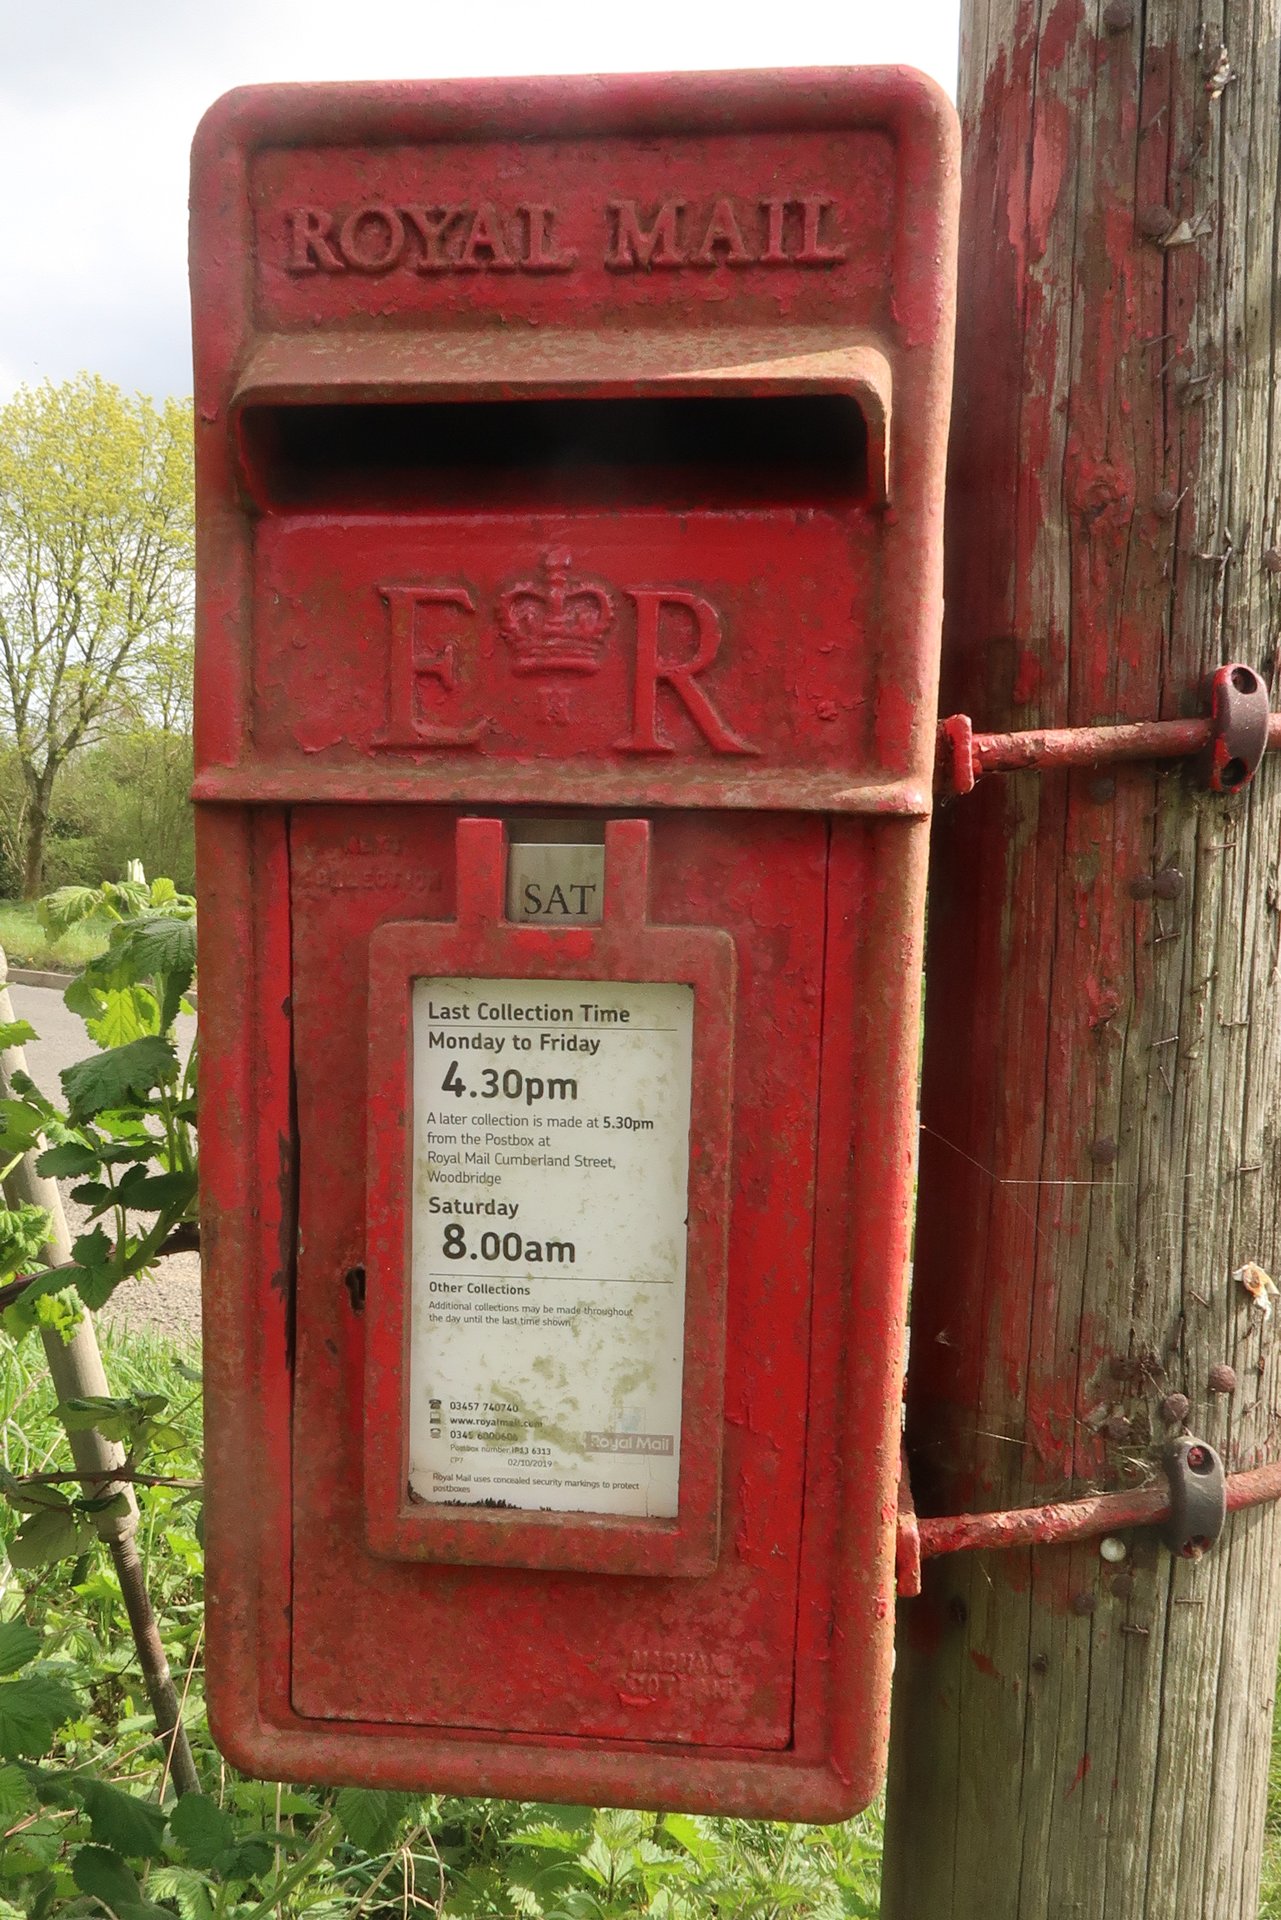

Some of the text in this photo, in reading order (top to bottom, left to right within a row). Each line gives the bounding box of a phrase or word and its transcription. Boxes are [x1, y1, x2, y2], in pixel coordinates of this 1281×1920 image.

[286, 198, 848, 274] ROYAL MAIL
[368, 585, 762, 754] E R
[524, 884, 597, 915] SAT
[428, 1002, 630, 1022] Last Collection Time
[428, 1032, 600, 1055] Monday to Friday
[441, 1060, 578, 1106] 4.30pm
[427, 1113, 654, 1131] A later collection is made at 5.30pm
[427, 1133, 550, 1147] from the Postbox at
[427, 1152, 616, 1169] Royal Mail Cumberland Street,
[428, 1171, 502, 1185] Woodbridge
[429, 1197, 519, 1219] Saturday
[442, 1223, 576, 1263] 8.00am
[429, 1282, 530, 1295] Other Collections
[429, 1301, 633, 1318] Additional collections may be made throughout
[429, 1313, 443, 1322] the
[445, 1314, 461, 1324] day
[463, 1315, 482, 1323] until
[485, 1315, 499, 1324] the
[502, 1315, 518, 1325] last
[520, 1316, 540, 1326] time
[450, 1402, 518, 1412] 03457 740740
[450, 1418, 542, 1428] www.royalmail.com
[450, 1430, 473, 1439] 0345
[591, 1435, 669, 1450] Royal Mail
[532, 1447, 551, 1455] 6313
[508, 1459, 552, 1467] 02/10/2019
[432, 1472, 453, 1481] Royal
[456, 1474, 471, 1482] Mail
[493, 1477, 530, 1485] concealed
[532, 1478, 563, 1487] security
[565, 1480, 600, 1488] markings
[612, 1482, 640, 1490] protect
